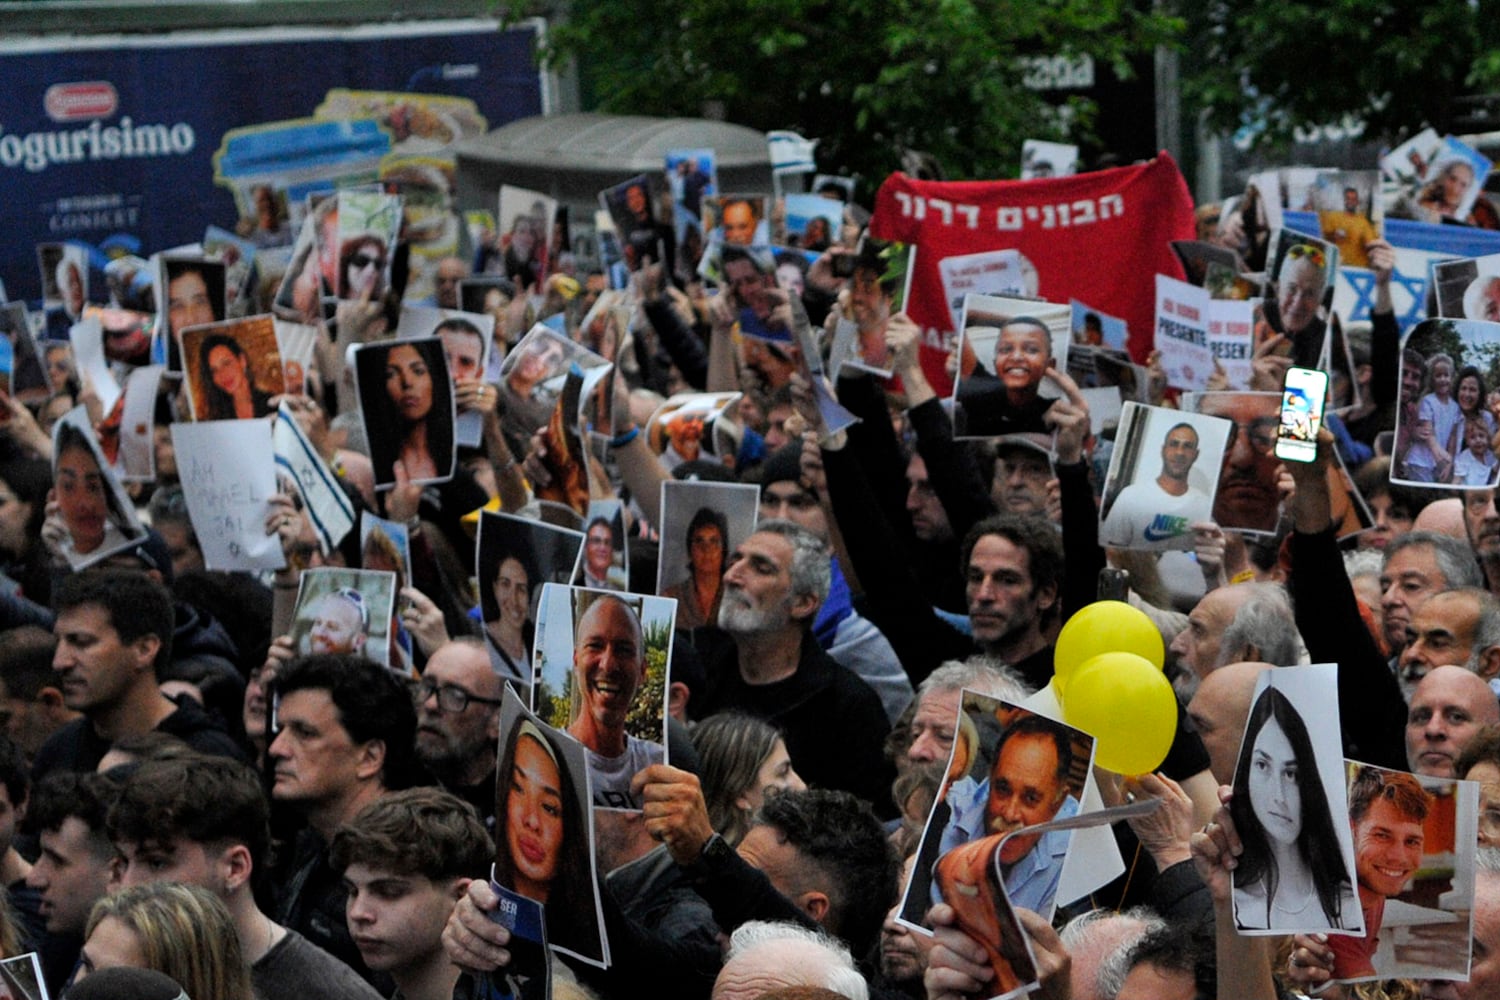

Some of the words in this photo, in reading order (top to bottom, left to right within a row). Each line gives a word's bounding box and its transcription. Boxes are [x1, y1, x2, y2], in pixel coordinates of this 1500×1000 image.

[0, 116, 195, 172] ogurísimo
[894, 191, 980, 229] דרור
[997, 193, 1125, 231] הבונים
[1158, 316, 1206, 348] PRESENTE
[1150, 513, 1188, 531] NIKE
